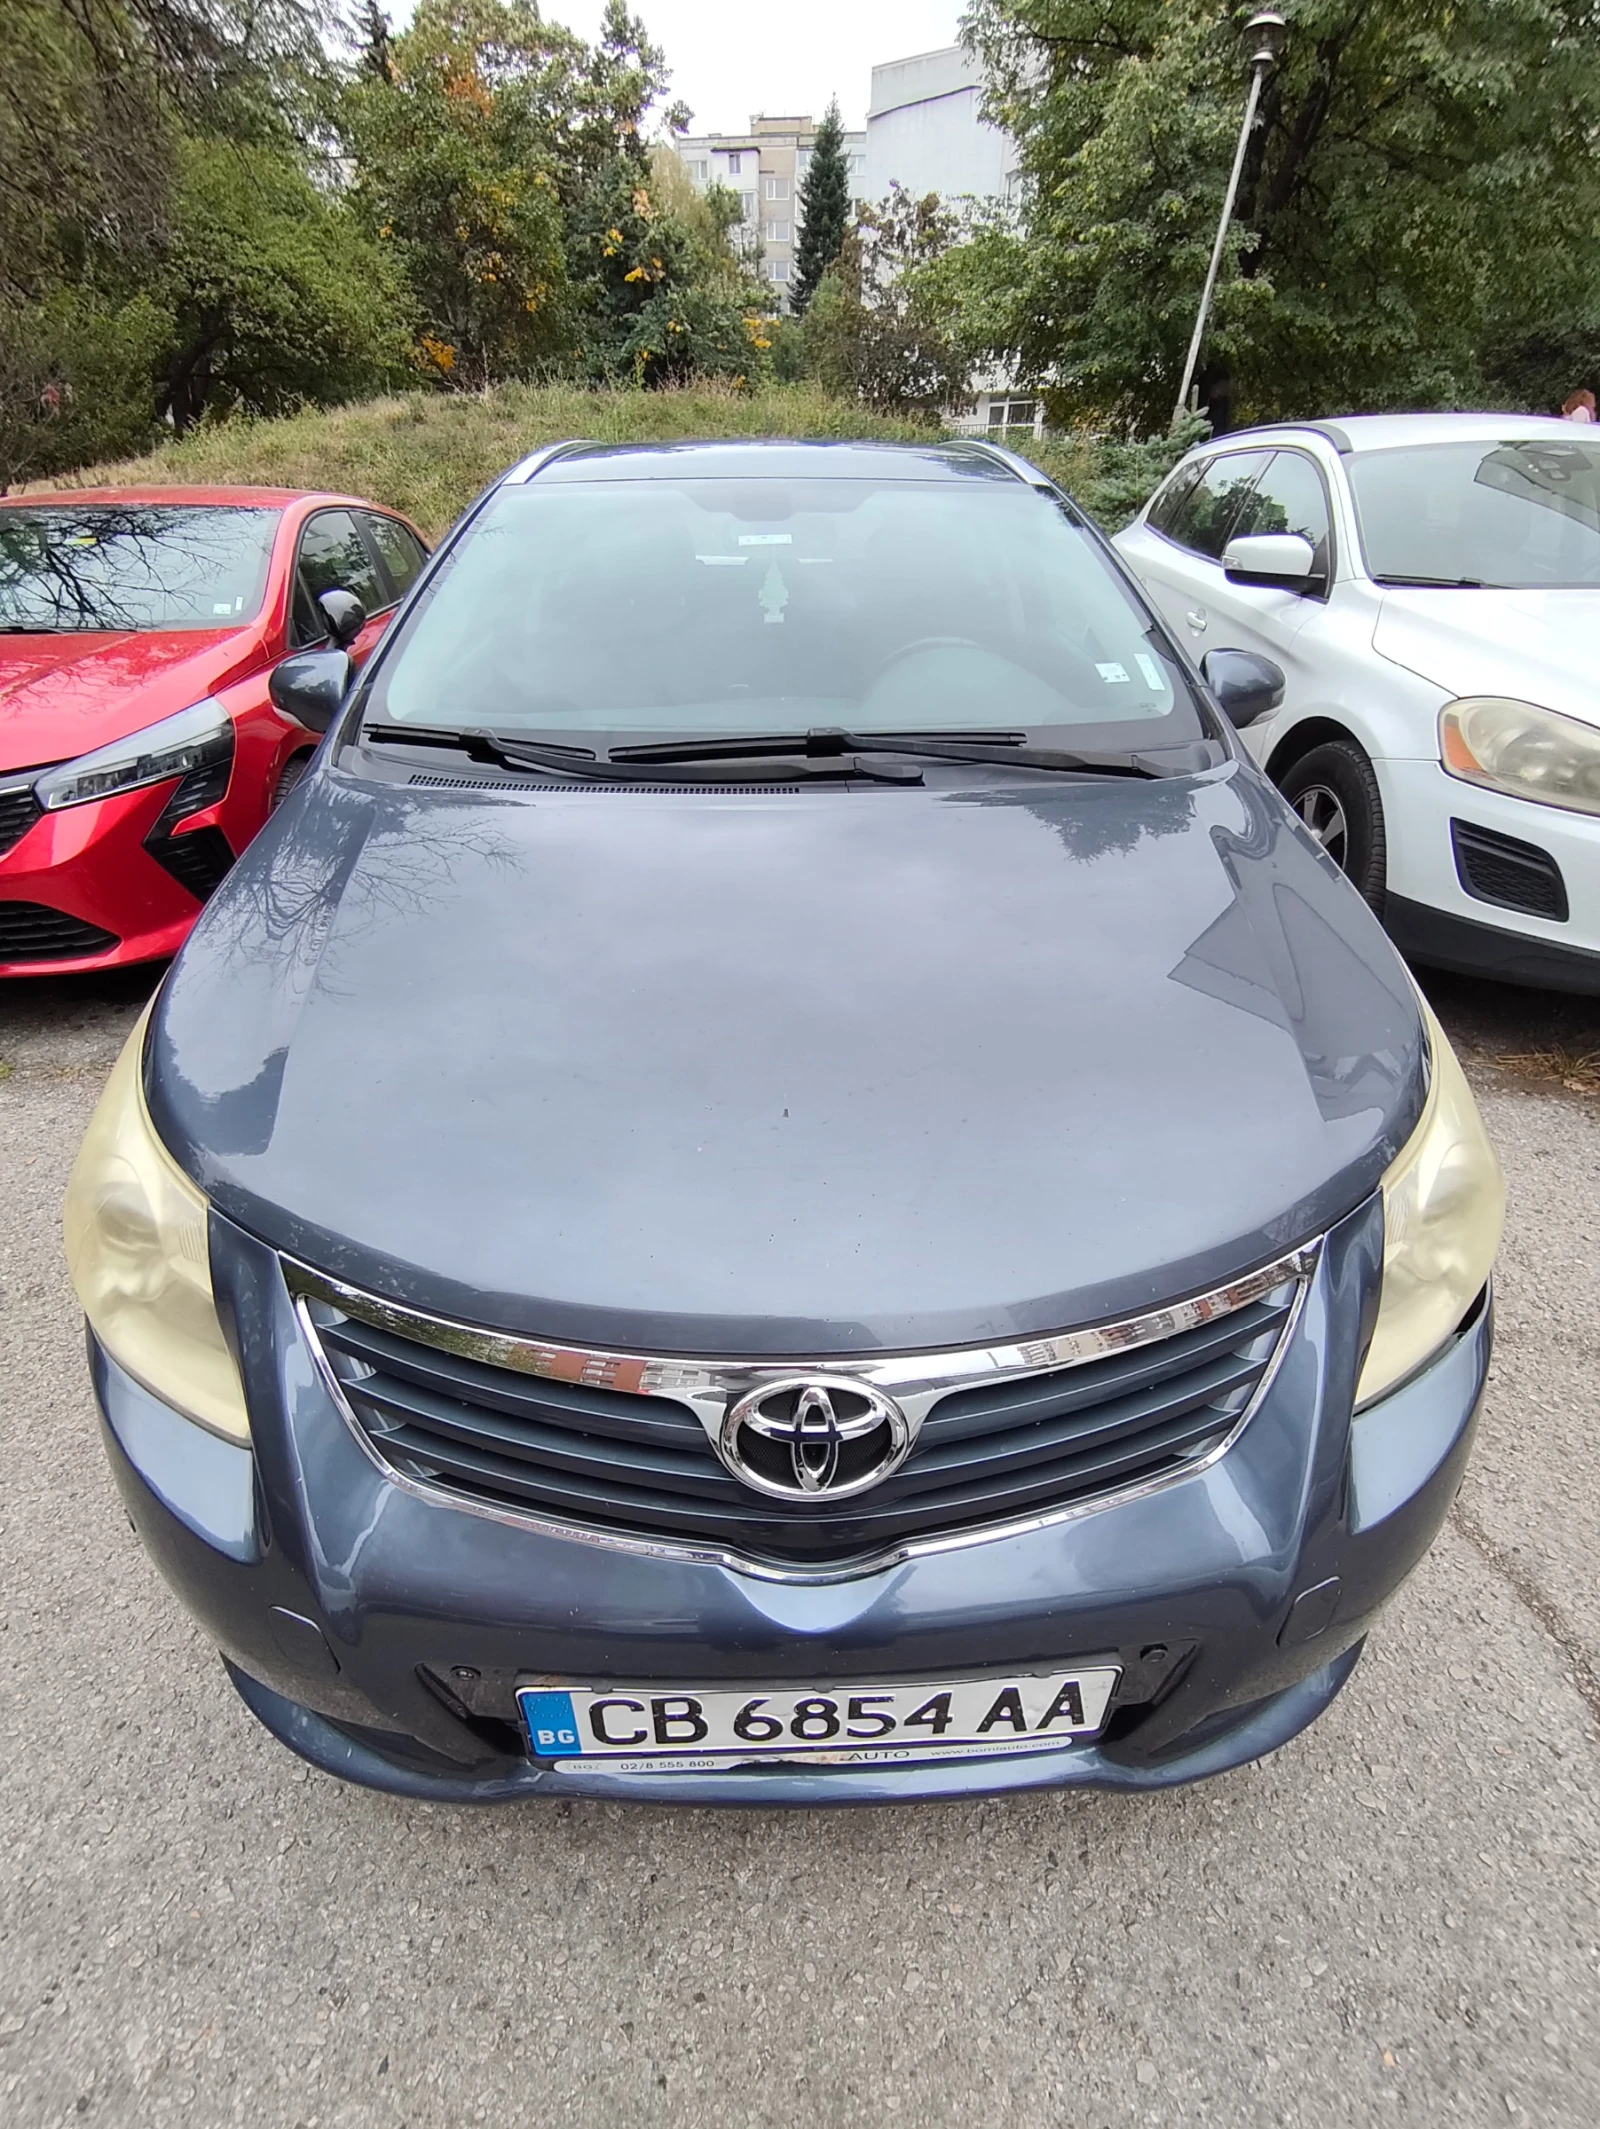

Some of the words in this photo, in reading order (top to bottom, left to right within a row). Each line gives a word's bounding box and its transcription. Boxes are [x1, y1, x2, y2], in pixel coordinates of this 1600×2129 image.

[587, 1696, 709, 1746] CB
[733, 1691, 954, 1742] 6854
[976, 1681, 1087, 1734] AA
[537, 1729, 574, 1746] BG
[848, 1750, 910, 1762] AUTO
[930, 1741, 1060, 1756] www.bomiauto.com
[620, 1759, 654, 1771] 02/8
[659, 1759, 685, 1769] 555
[689, 1759, 715, 1769] 800
